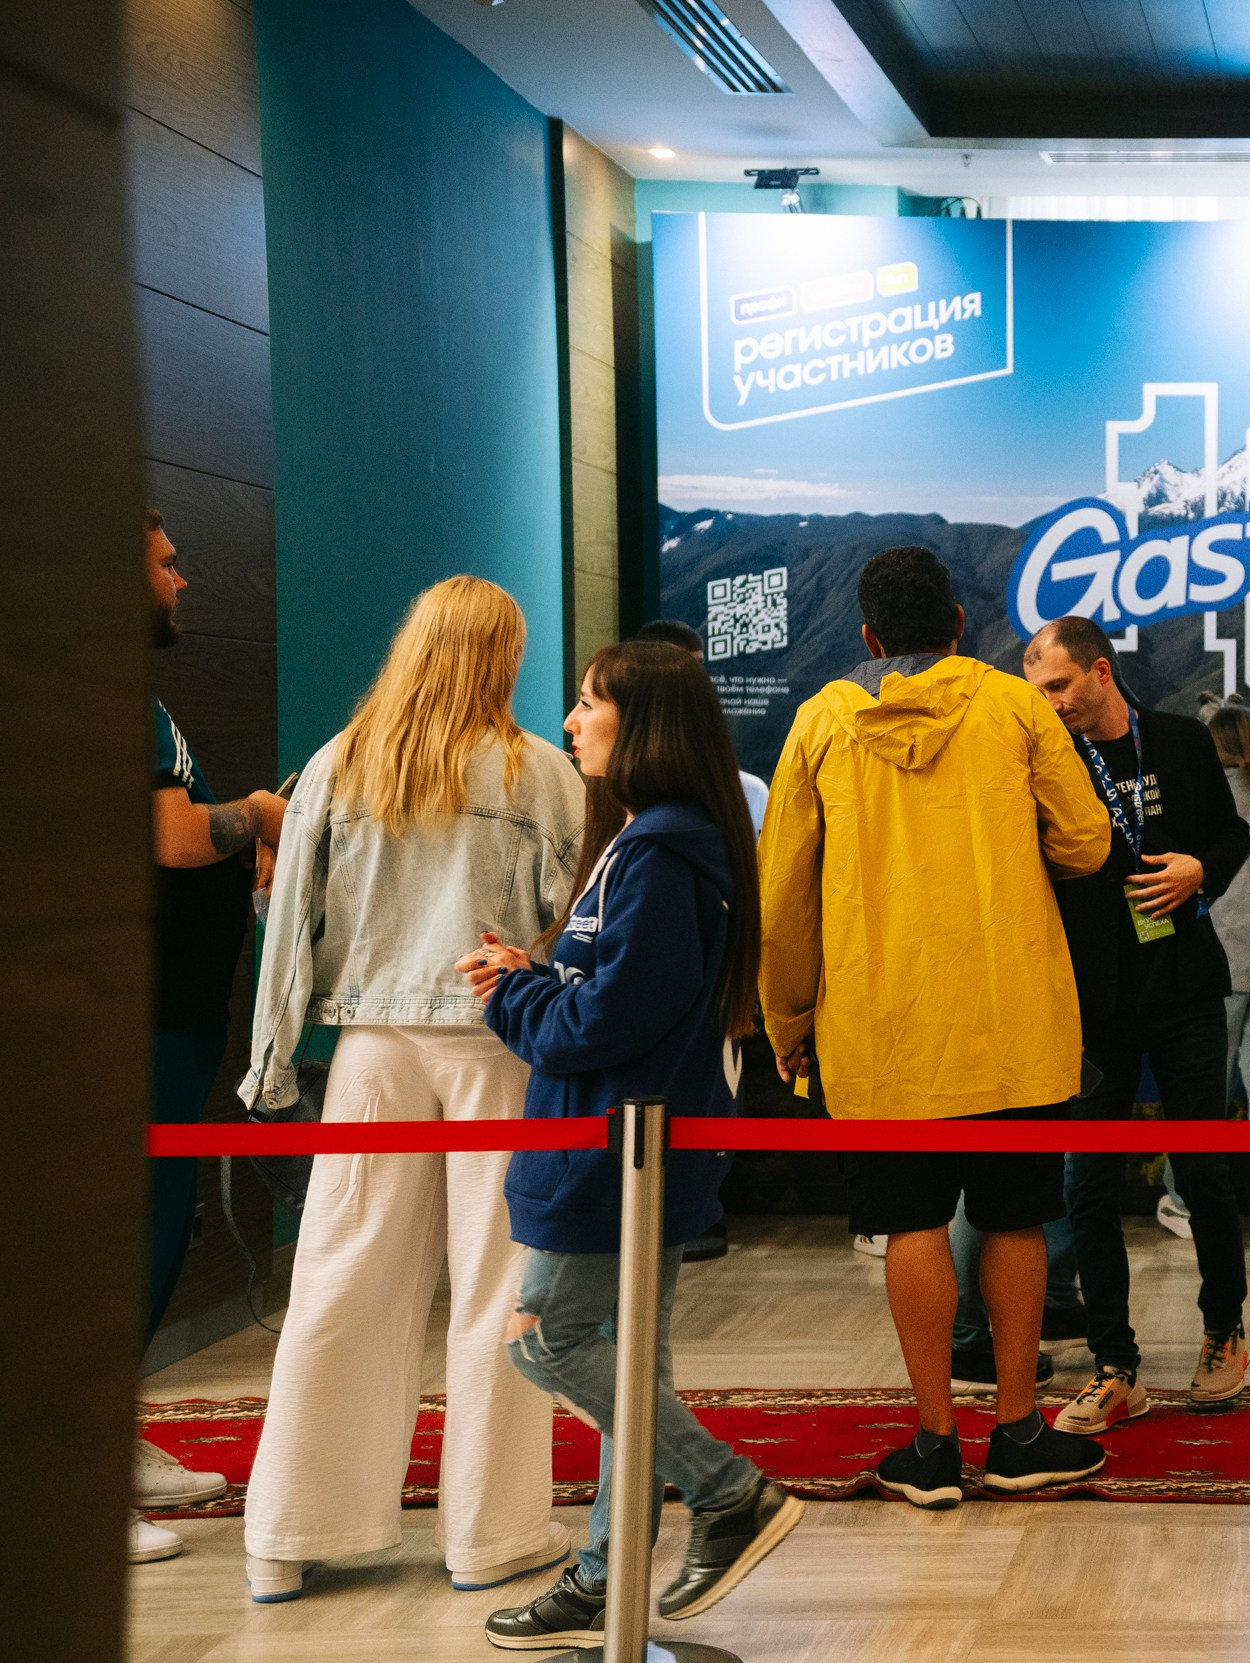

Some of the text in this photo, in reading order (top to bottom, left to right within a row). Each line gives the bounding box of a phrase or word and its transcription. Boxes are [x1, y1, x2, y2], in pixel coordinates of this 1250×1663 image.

[733, 292, 982, 372] регистрация
[733, 333, 955, 406] участников
[745, 677, 776, 685] нужно
